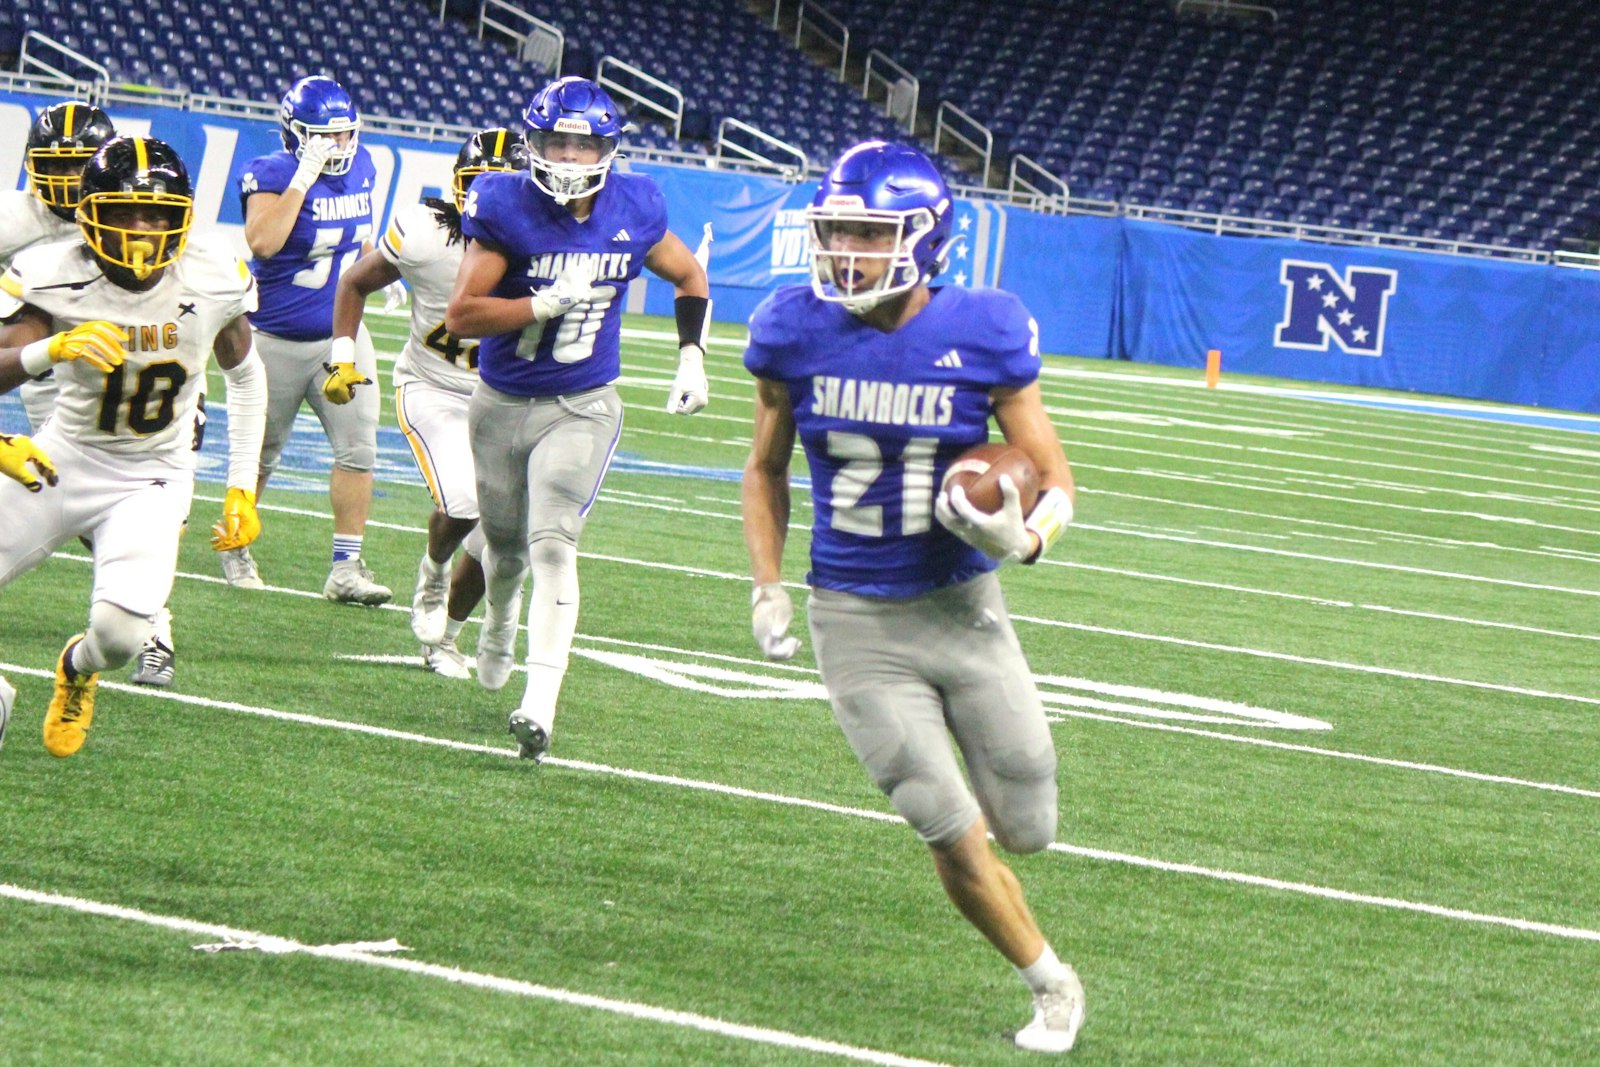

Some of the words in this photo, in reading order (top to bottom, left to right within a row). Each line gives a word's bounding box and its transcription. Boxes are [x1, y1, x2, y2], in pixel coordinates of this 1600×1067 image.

[557, 120, 588, 131] Riddell
[771, 228, 811, 267] VOT
[1273, 258, 1398, 358] N
[119, 322, 178, 352] ING
[811, 375, 956, 426] SHAMROCKS
[827, 430, 940, 537] 21
